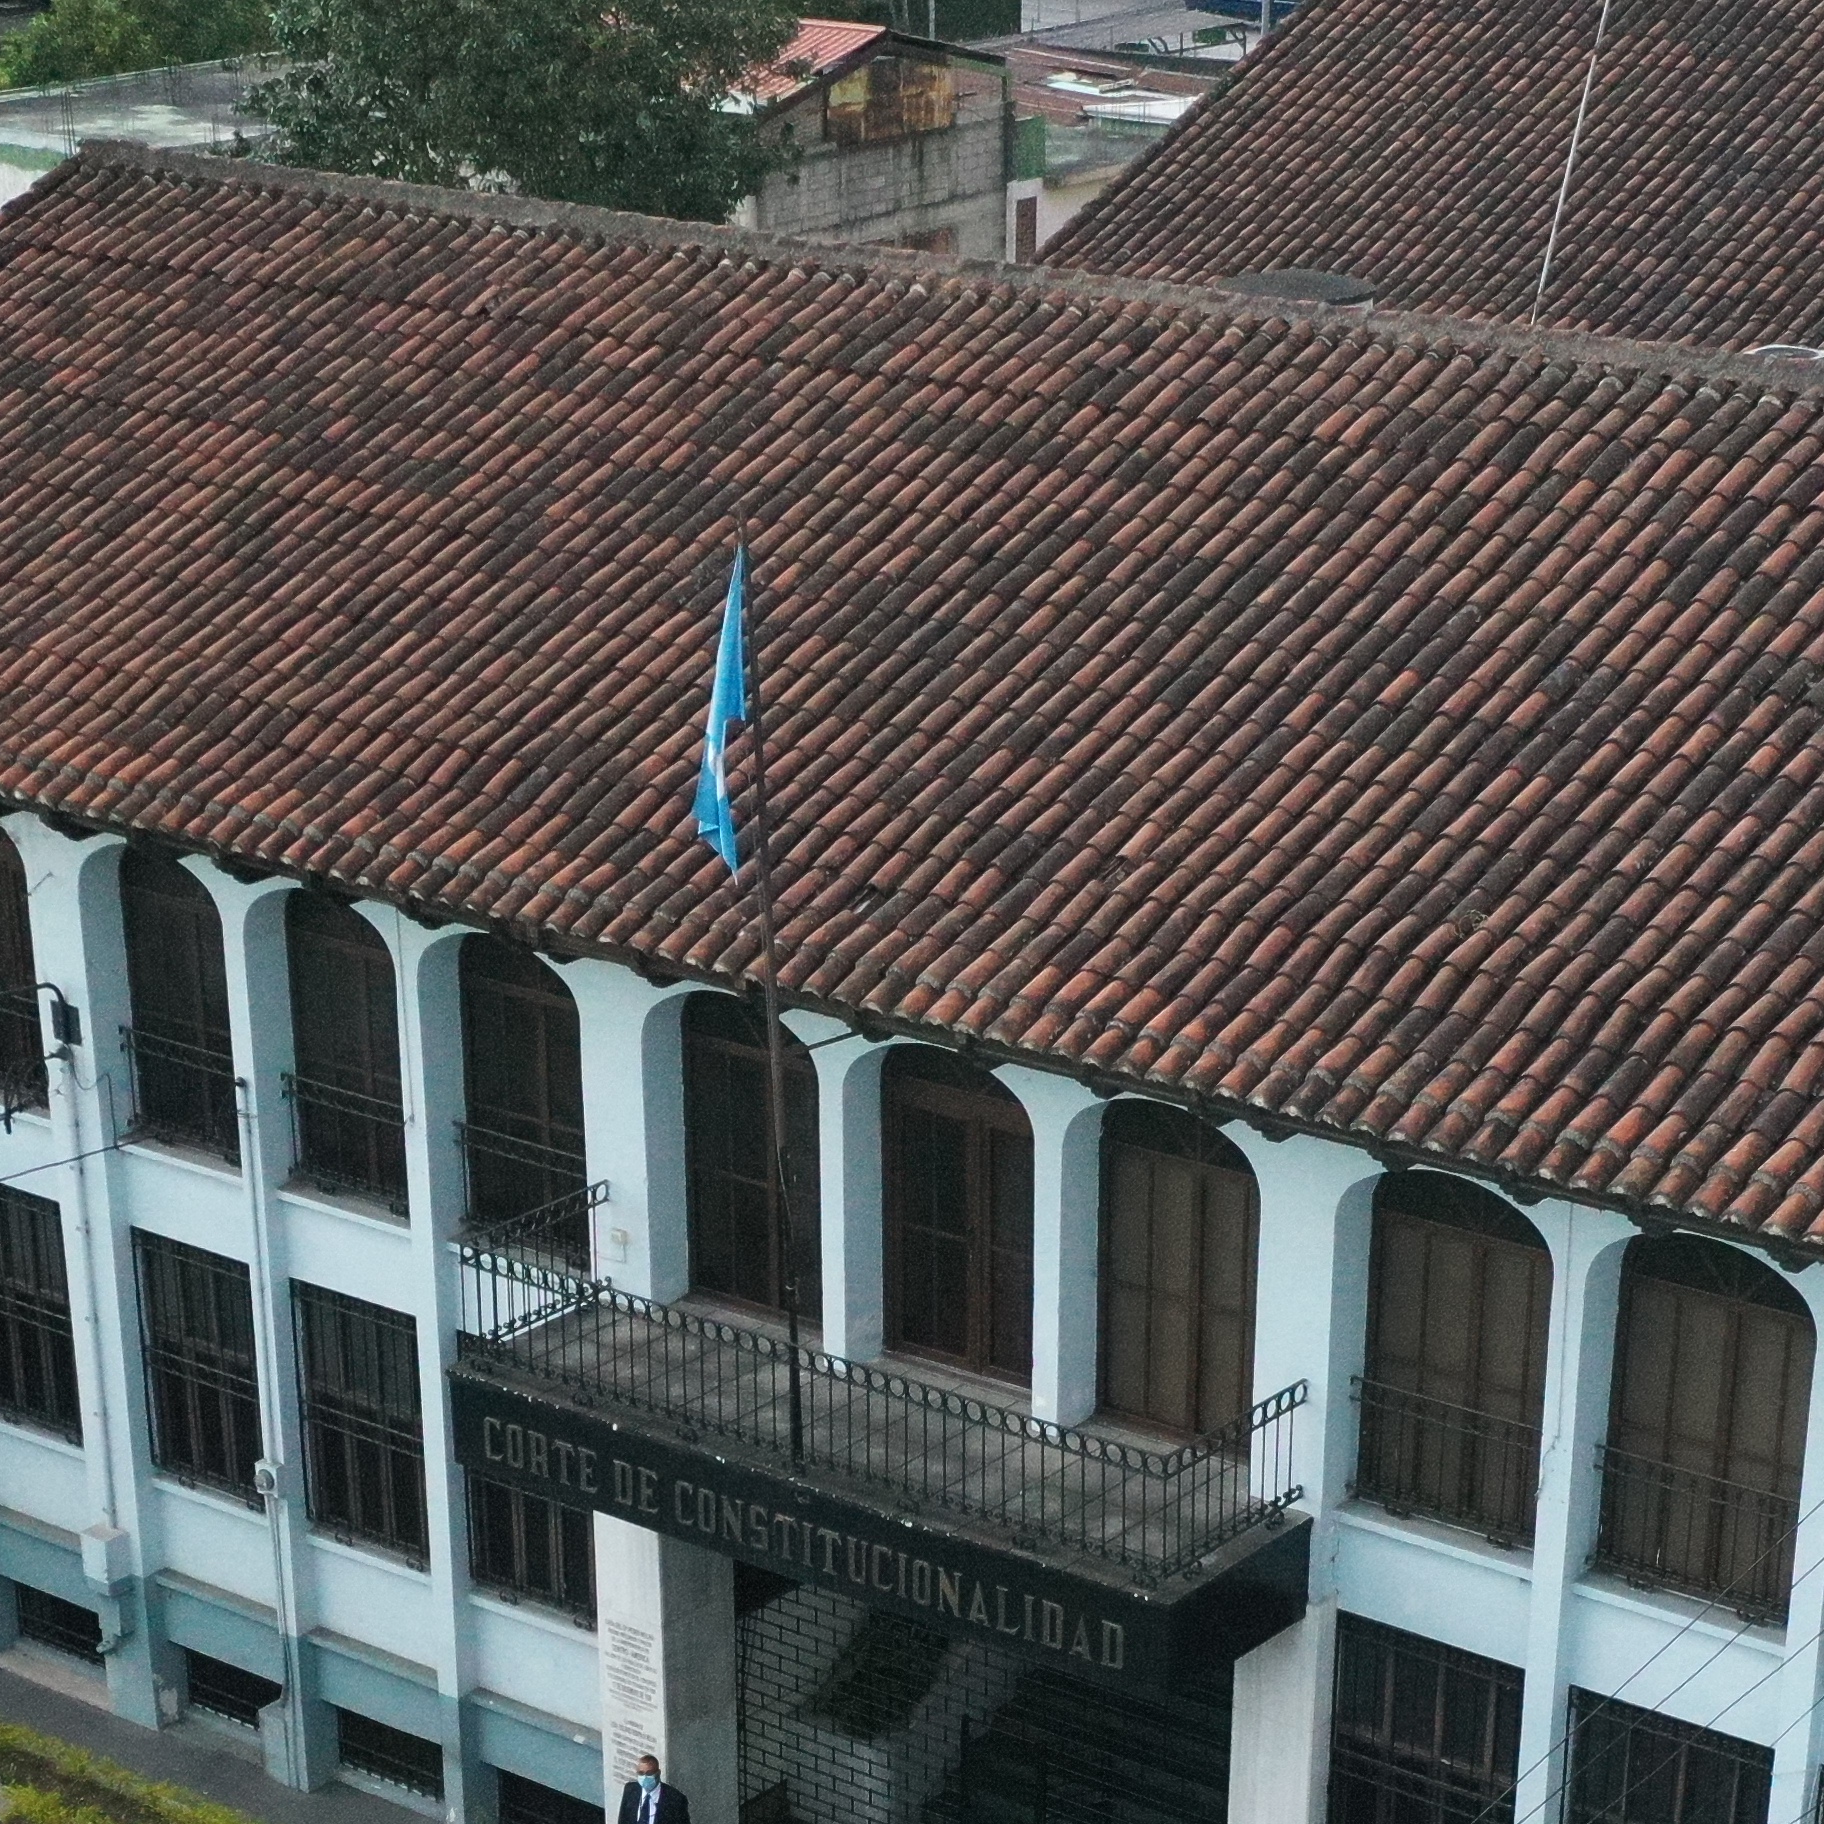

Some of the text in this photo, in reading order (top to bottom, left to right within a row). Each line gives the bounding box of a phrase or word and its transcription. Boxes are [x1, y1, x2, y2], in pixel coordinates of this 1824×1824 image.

[483, 1416, 598, 1494] CORTE
[613, 1459, 660, 1514] DE
[675, 1480, 1124, 1670] CONSTITUCIONALIDAD
